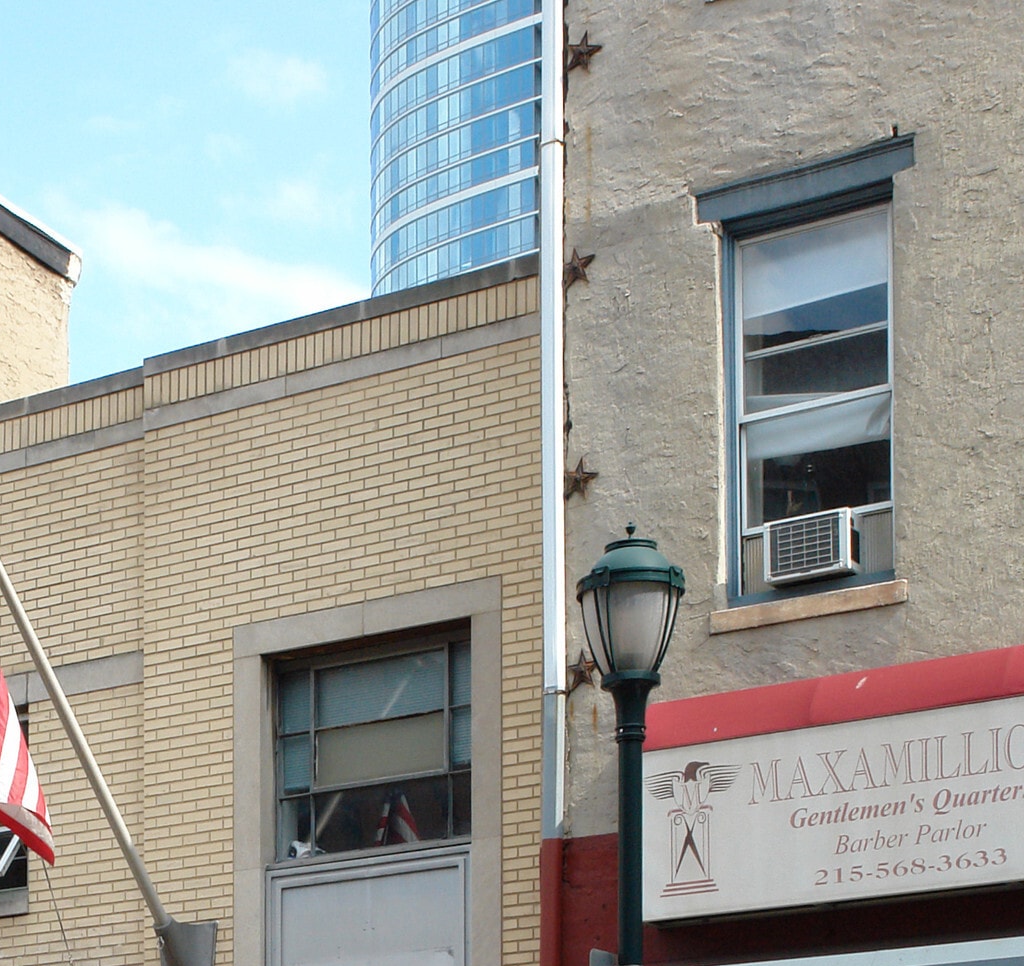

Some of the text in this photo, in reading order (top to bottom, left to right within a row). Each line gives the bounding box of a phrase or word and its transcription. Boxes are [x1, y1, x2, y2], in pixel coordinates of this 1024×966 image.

[789, 784, 1024, 829] Gentlemen's Quarter
[833, 819, 987, 855] Barber Parlor
[814, 848, 1008, 886] 215-568-3633
